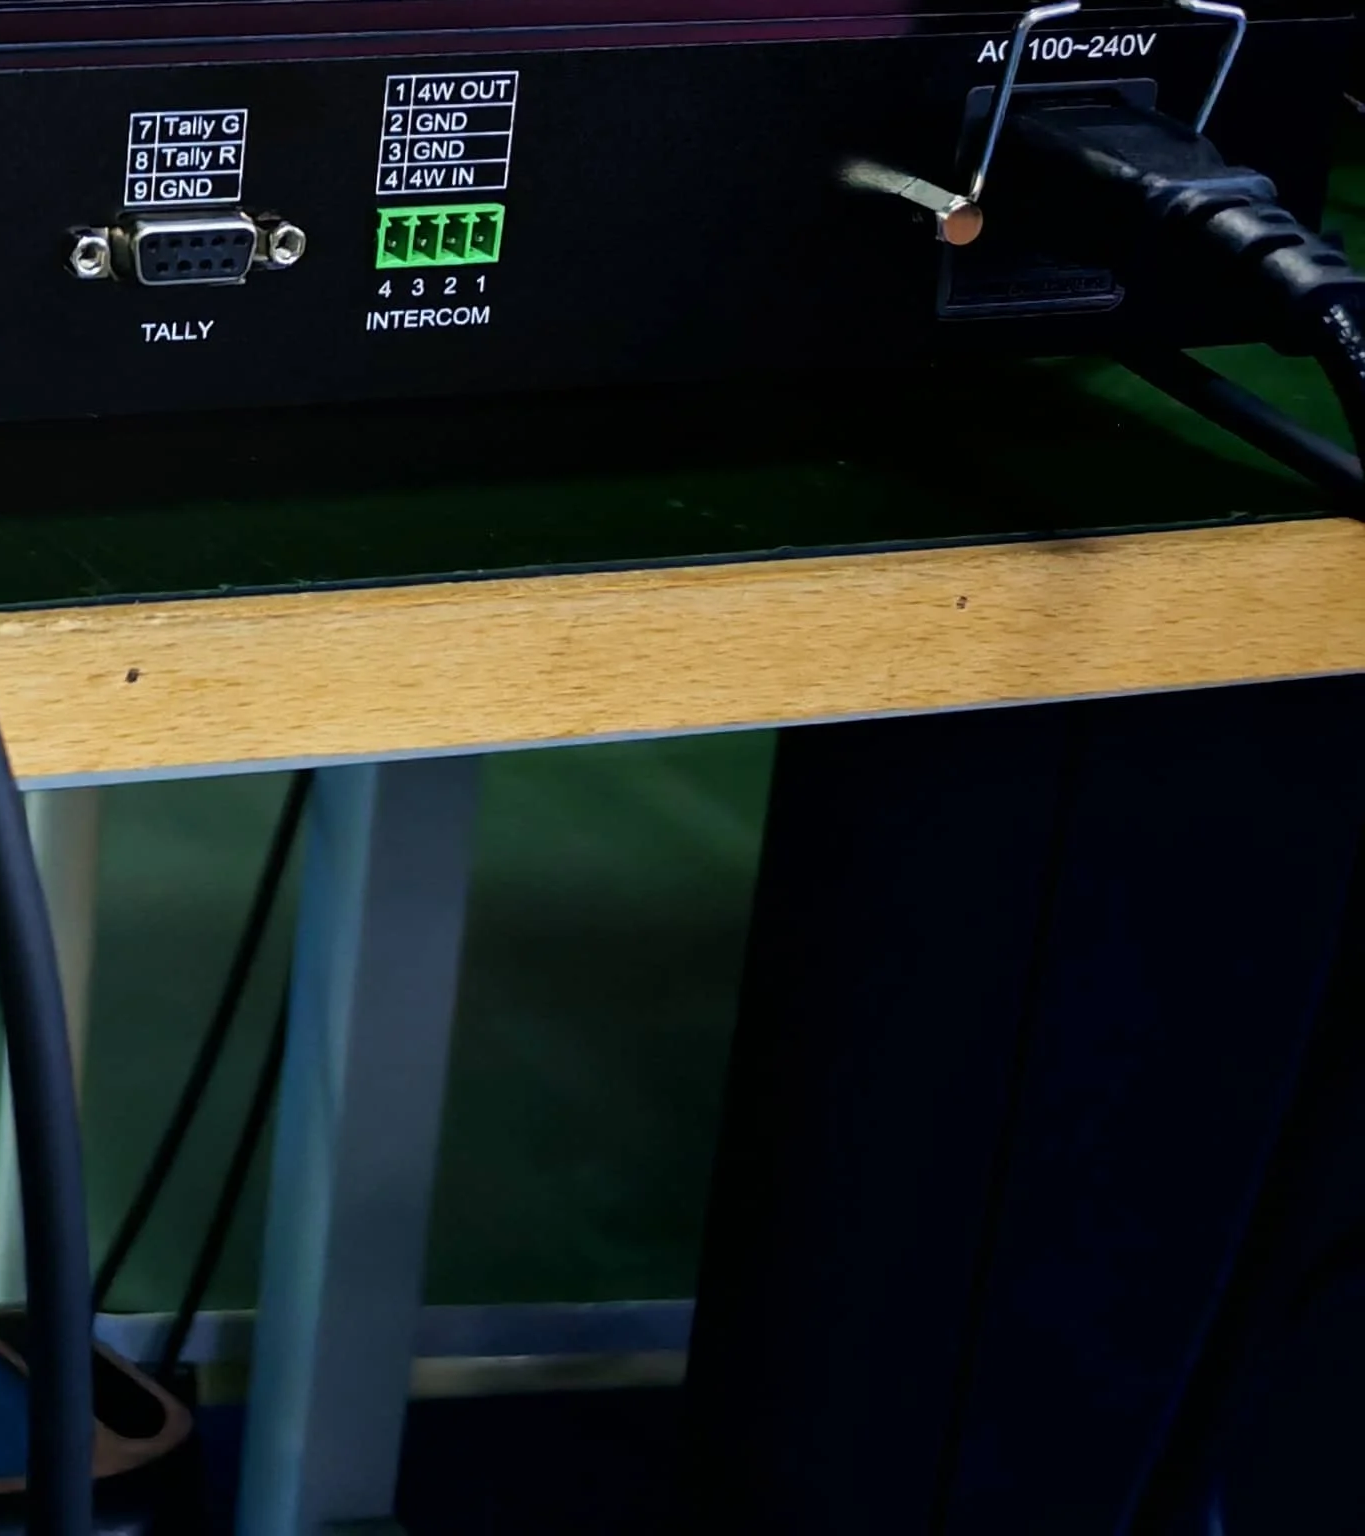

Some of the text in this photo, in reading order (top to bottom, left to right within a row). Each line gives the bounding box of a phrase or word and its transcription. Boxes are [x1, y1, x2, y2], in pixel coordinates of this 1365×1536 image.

[1028, 32, 1157, 61] 100~240V
[396, 79, 512, 102] 1 4W OUT
[138, 114, 240, 141] 7 Tally G
[389, 112, 469, 133] 2 GND
[135, 145, 237, 173] 8 Tally R
[388, 139, 466, 162] 3 GND
[133, 177, 214, 200] 9 GND
[384, 167, 476, 189] 4 4W IN
[378, 275, 486, 298] 4 3 2 1
[366, 305, 490, 331] INTERCOM
[140, 320, 214, 342] TALLY
